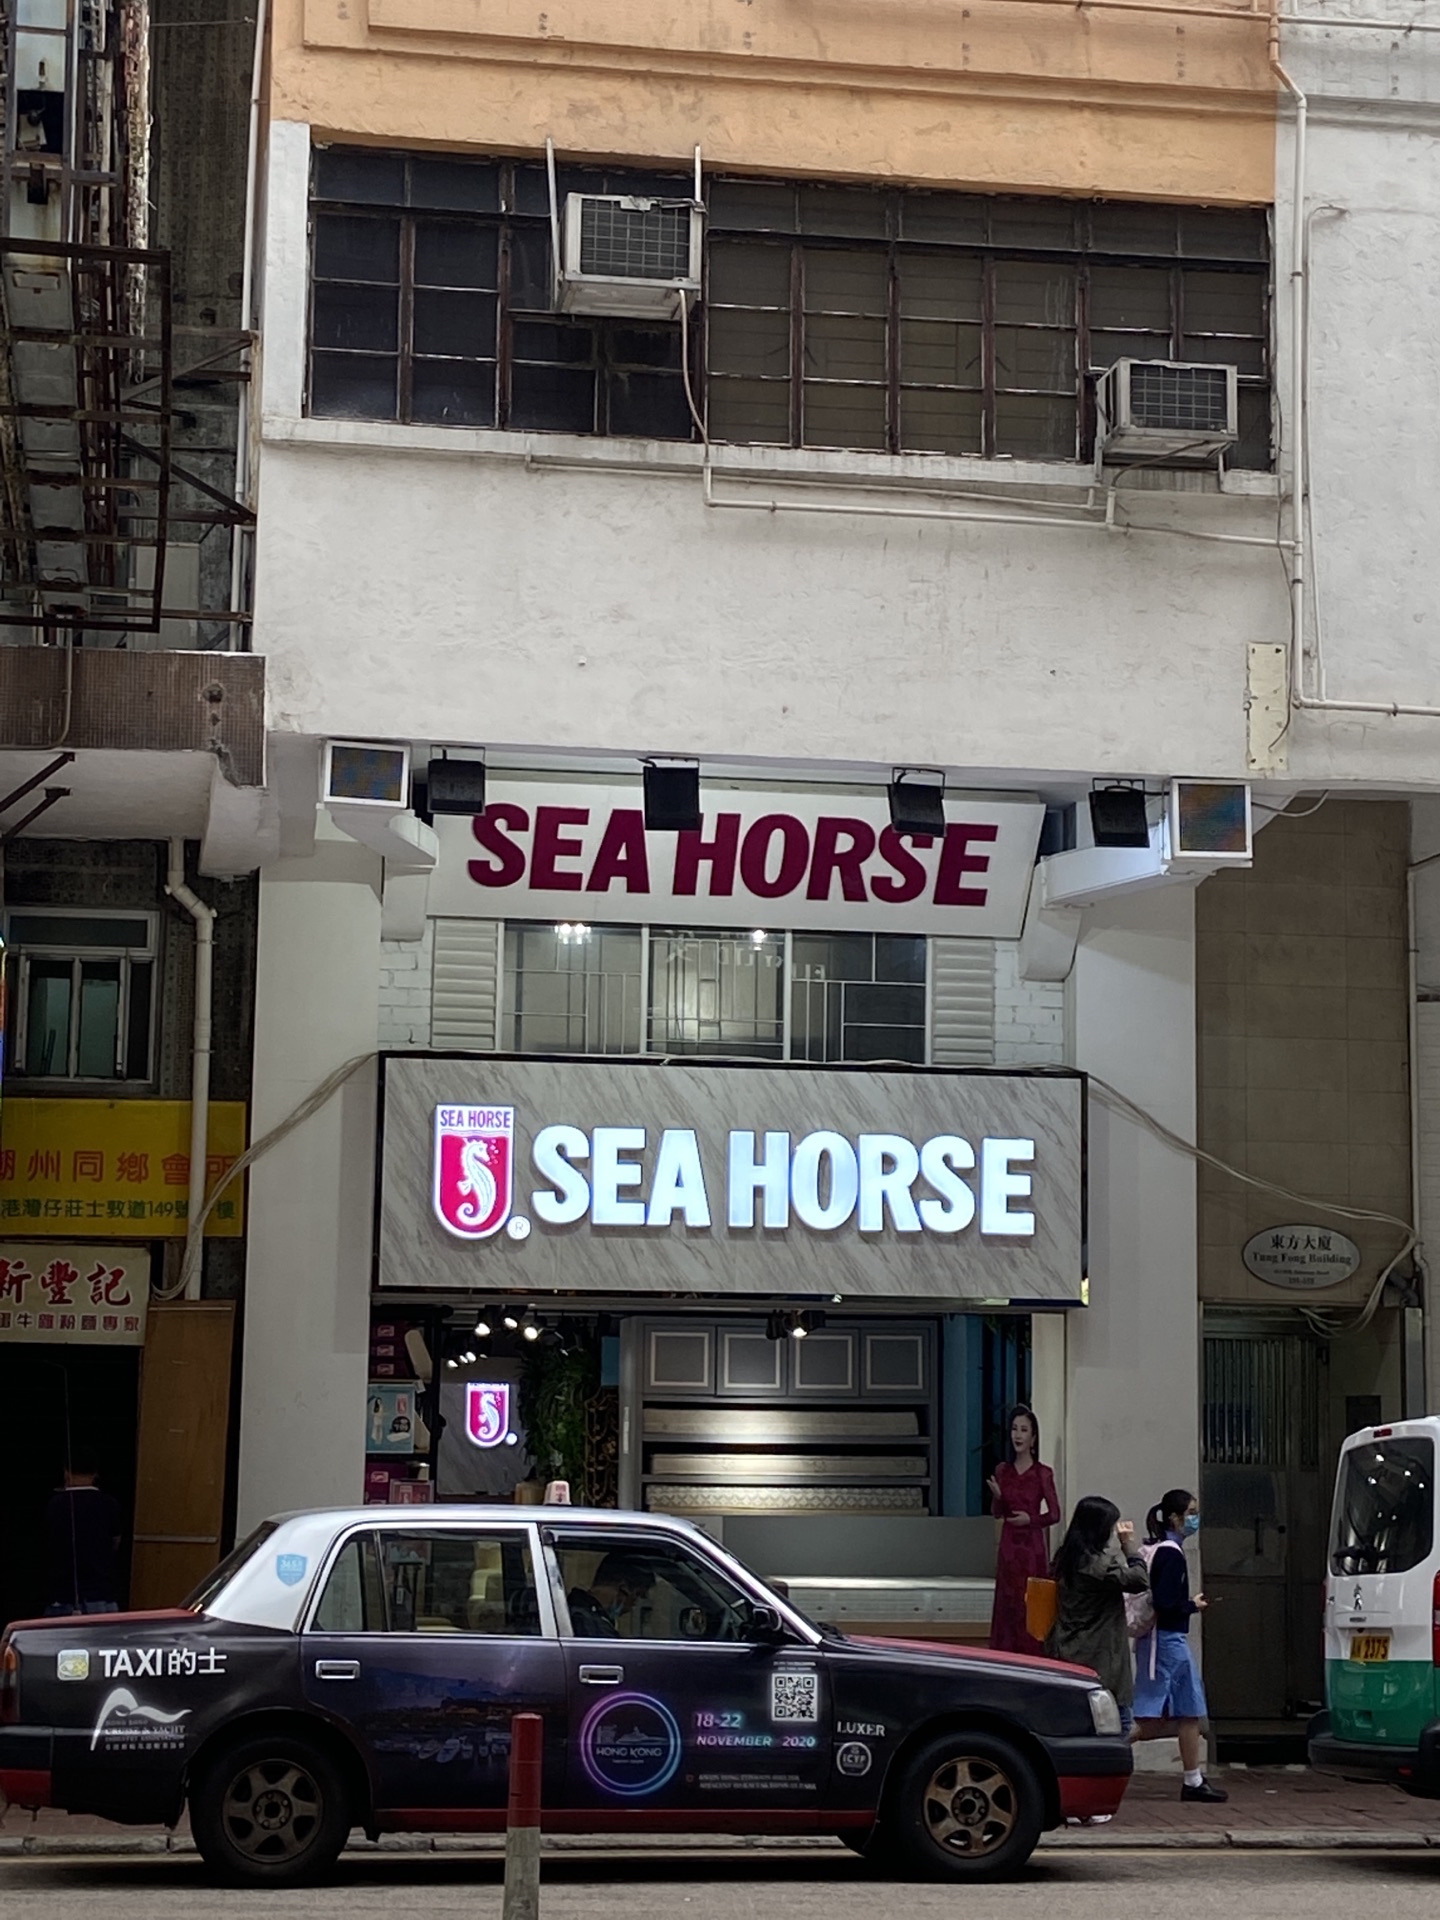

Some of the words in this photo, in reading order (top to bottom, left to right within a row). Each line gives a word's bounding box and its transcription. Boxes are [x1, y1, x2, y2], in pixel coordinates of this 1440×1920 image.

[467, 803, 650, 893] SEA
[672, 812, 999, 907] HORSE
[440, 1109, 464, 1127] SEA
[468, 1110, 511, 1128] HORSE
[532, 1125, 711, 1227] SEA
[728, 1129, 1035, 1236] HORSE
[1270, 1233, 1332, 1250] 東方大廈
[1253, 1251, 1278, 1264] Tung
[1281, 1252, 1306, 1265] Fong
[1309, 1253, 1352, 1266] Building
[98, 1647, 162, 1678] TAXI
[167, 1646, 228, 1676] 的士
[696, 1712, 742, 1728] 18-22
[836, 1720, 886, 1737] LUXER
[696, 1735, 772, 1746] NOVEMBER
[782, 1736, 817, 1747] 2020
[596, 1746, 628, 1757] HONG
